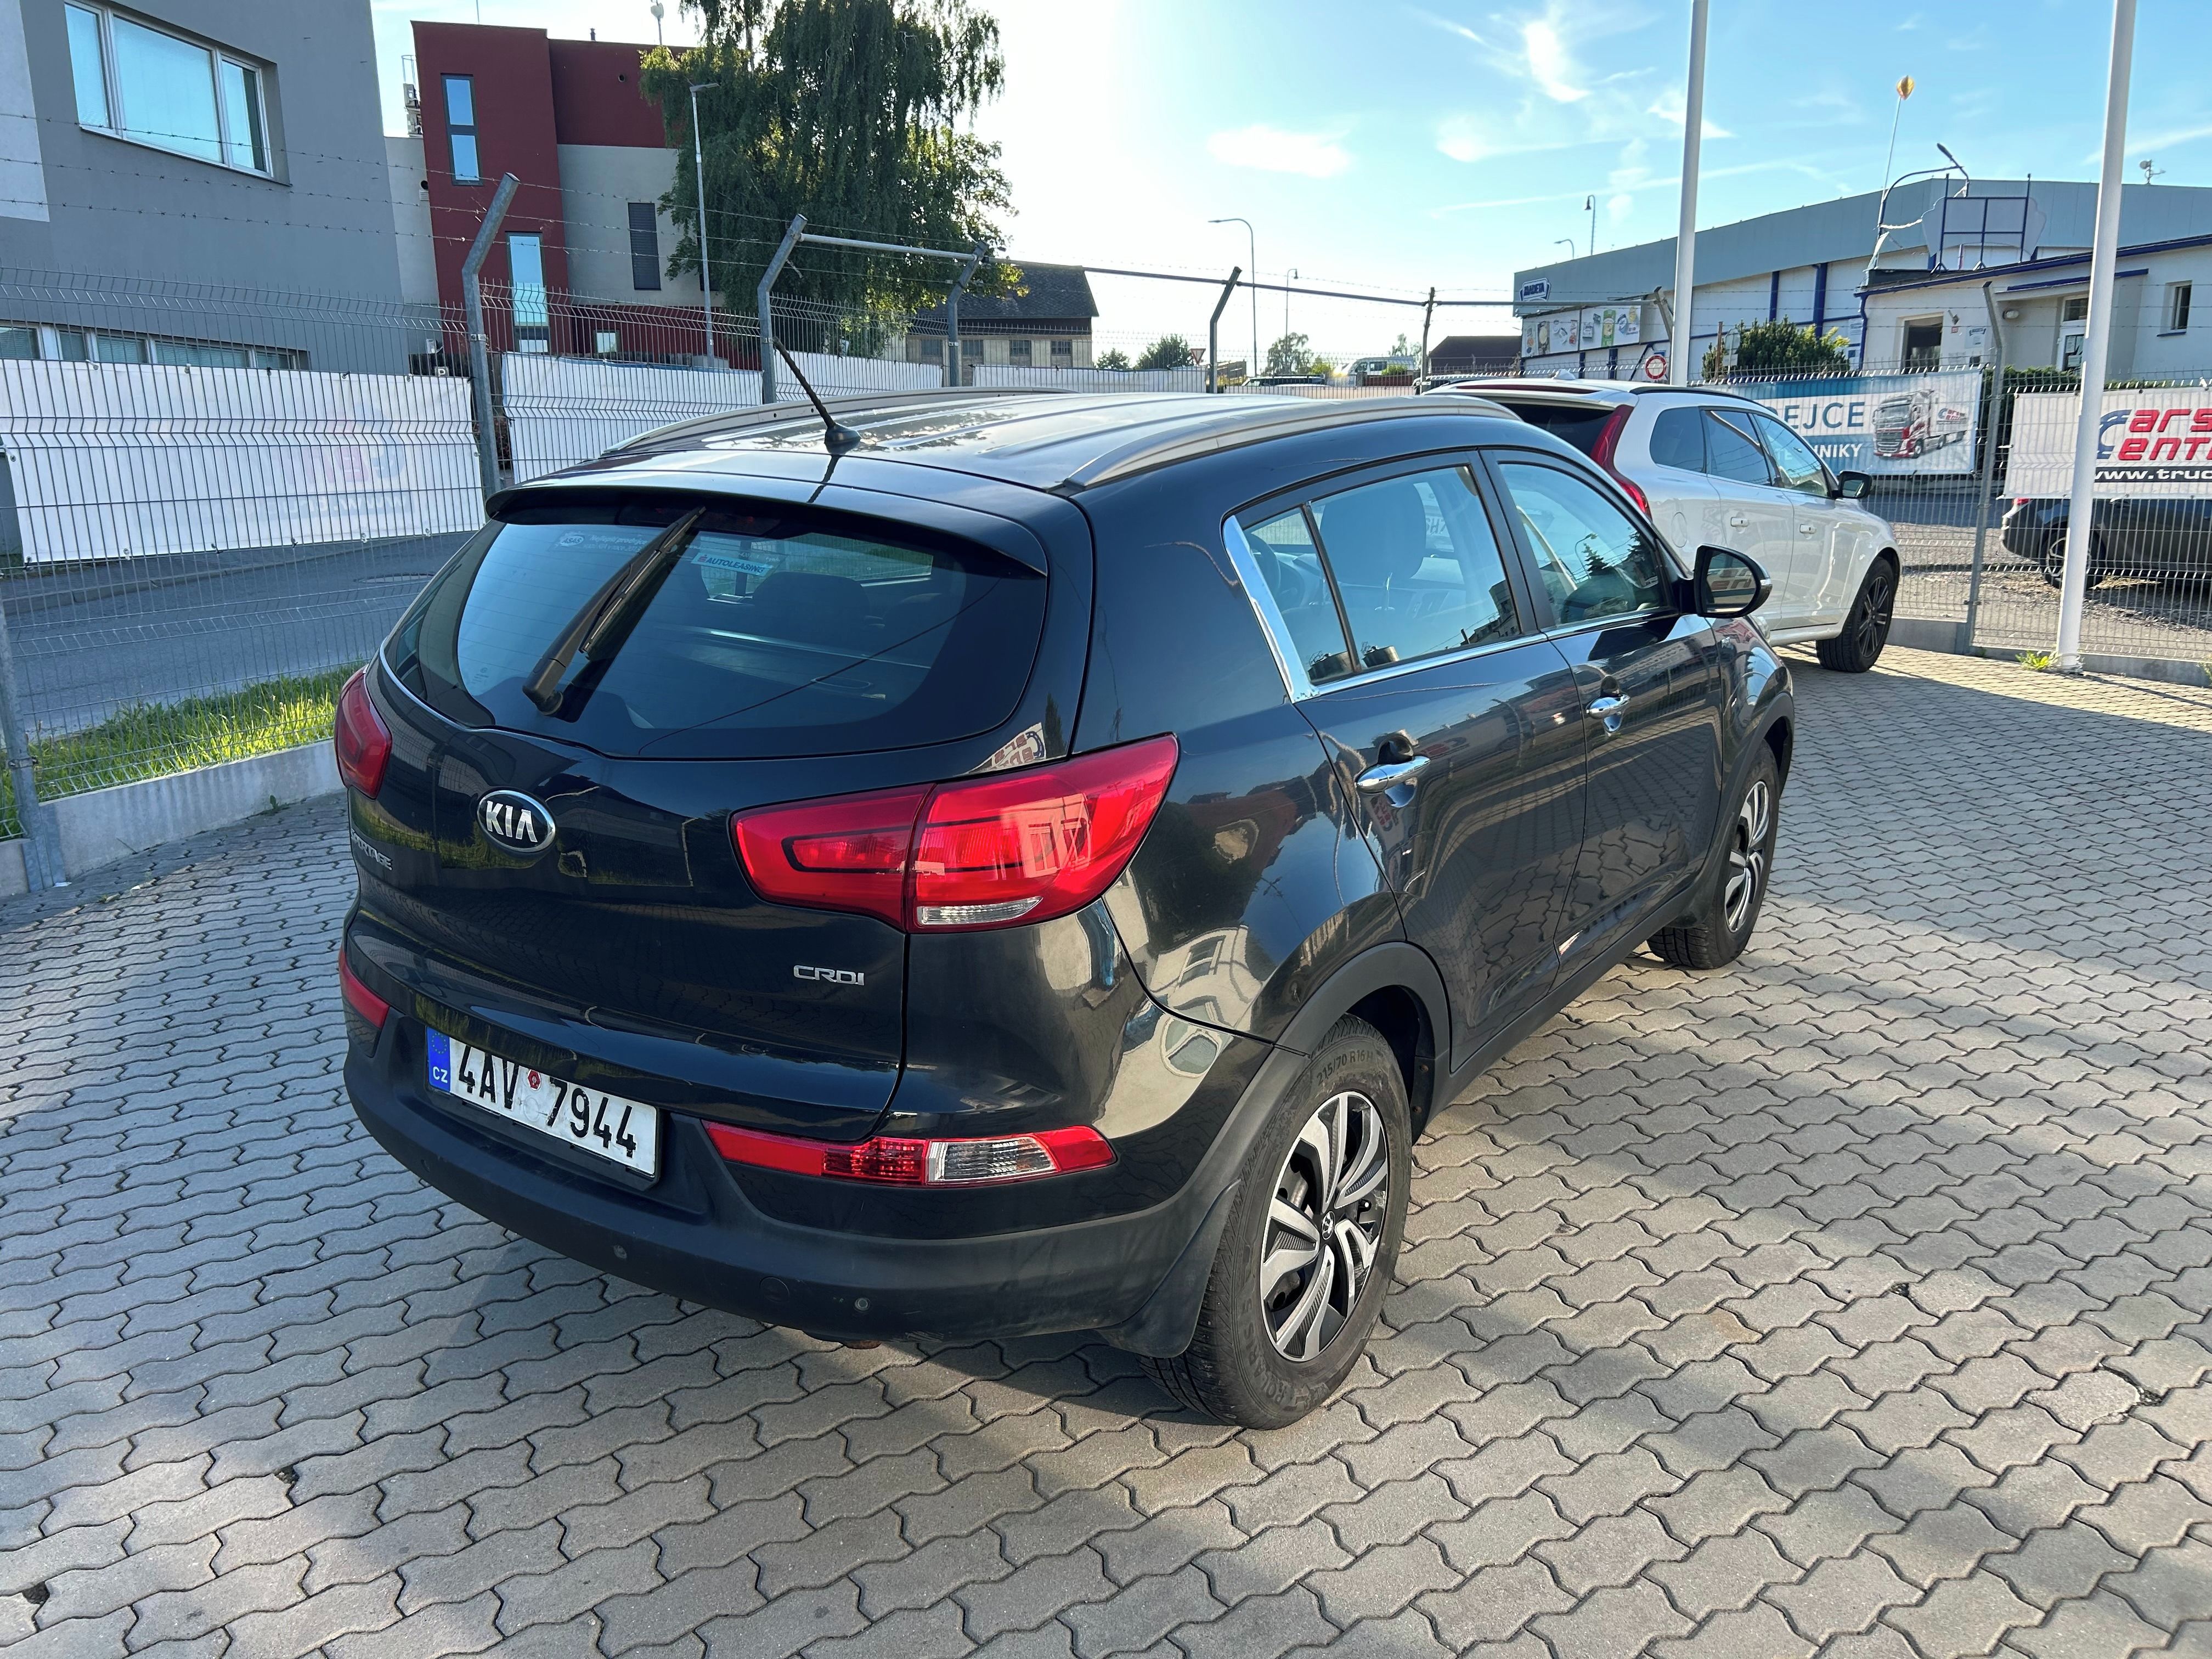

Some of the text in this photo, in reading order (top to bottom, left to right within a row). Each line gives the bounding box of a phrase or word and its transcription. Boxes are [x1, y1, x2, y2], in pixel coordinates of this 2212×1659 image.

[706, 557, 765, 573] AUTOLEASING
[486, 800, 538, 843] KIA
[793, 965, 865, 986] CRDI
[432, 1066, 448, 1084] CZ
[1317, 1053, 1347, 1086] 215/70
[459, 1045, 636, 1158] 4AV 7944
